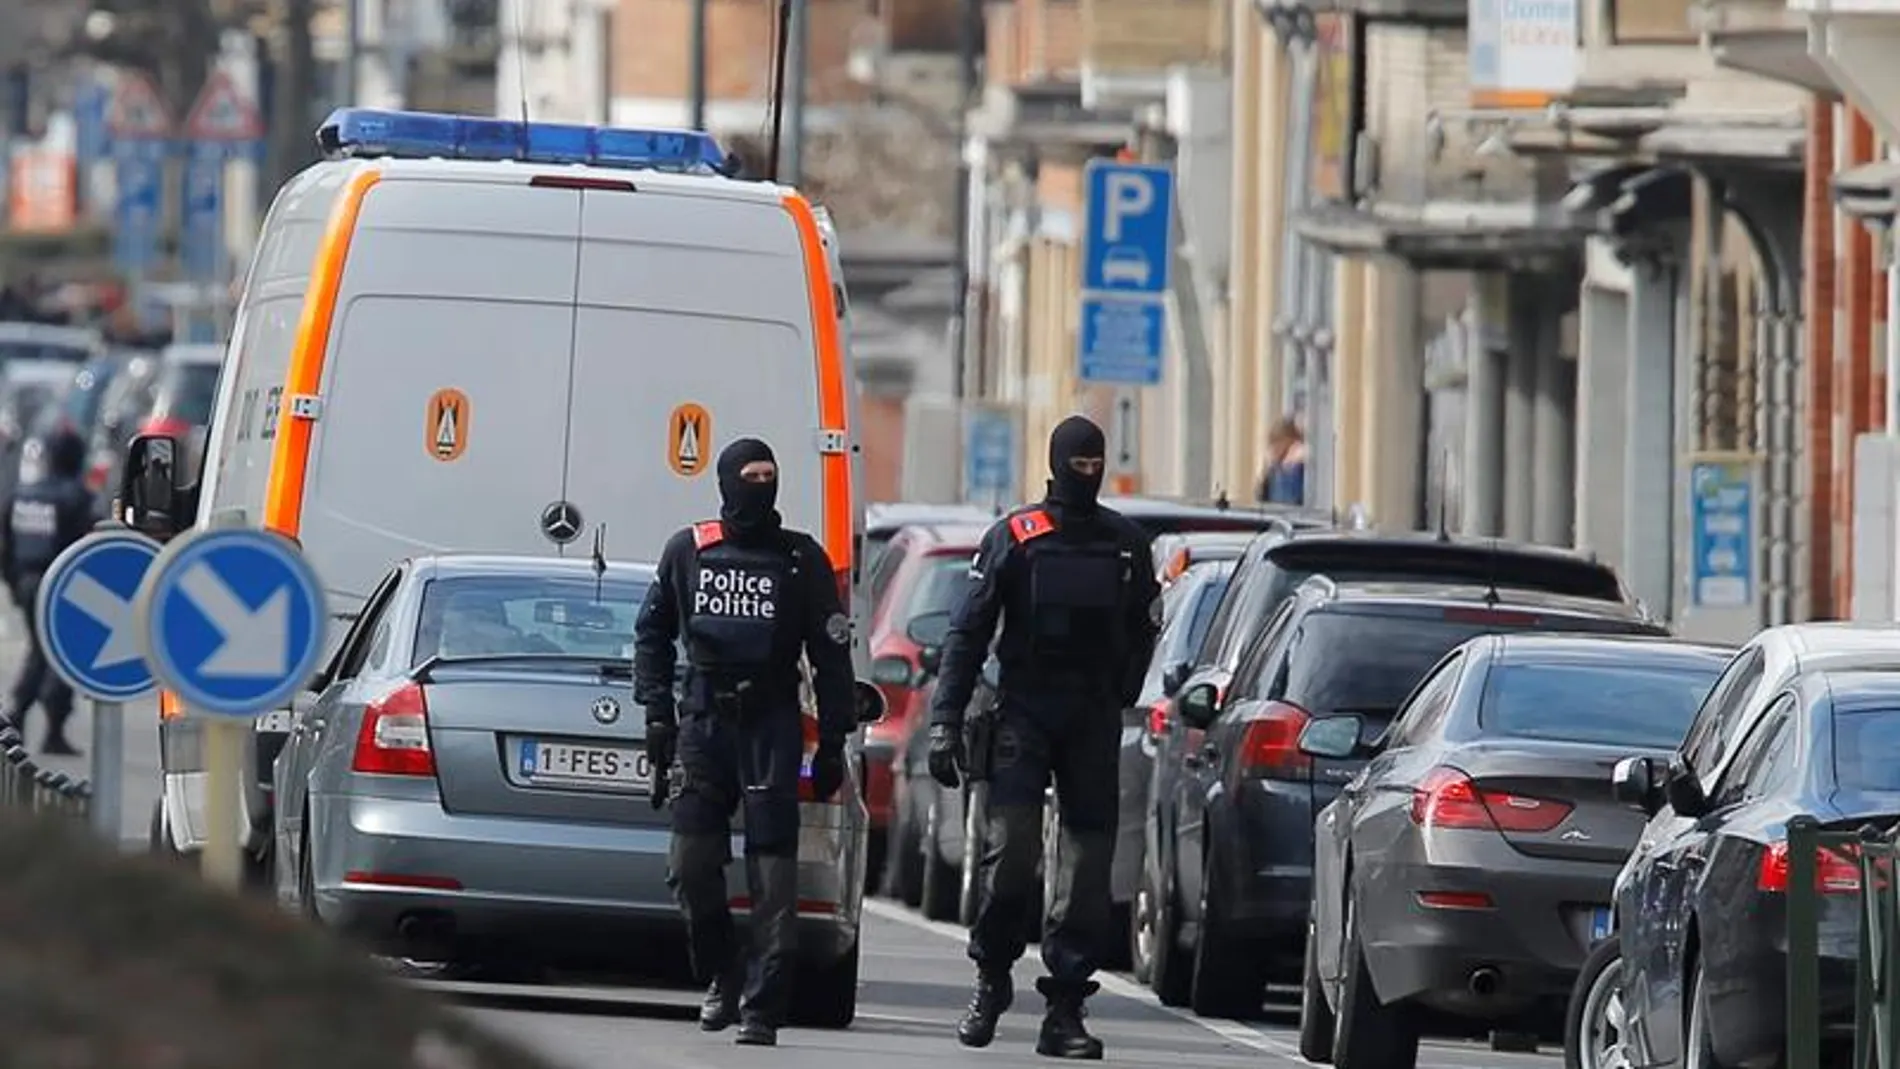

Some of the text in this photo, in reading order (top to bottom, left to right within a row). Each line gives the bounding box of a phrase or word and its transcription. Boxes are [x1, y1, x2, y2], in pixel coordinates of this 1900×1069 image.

[1104, 173, 1154, 242] P
[700, 568, 772, 594] Police
[695, 591, 775, 618] Politie
